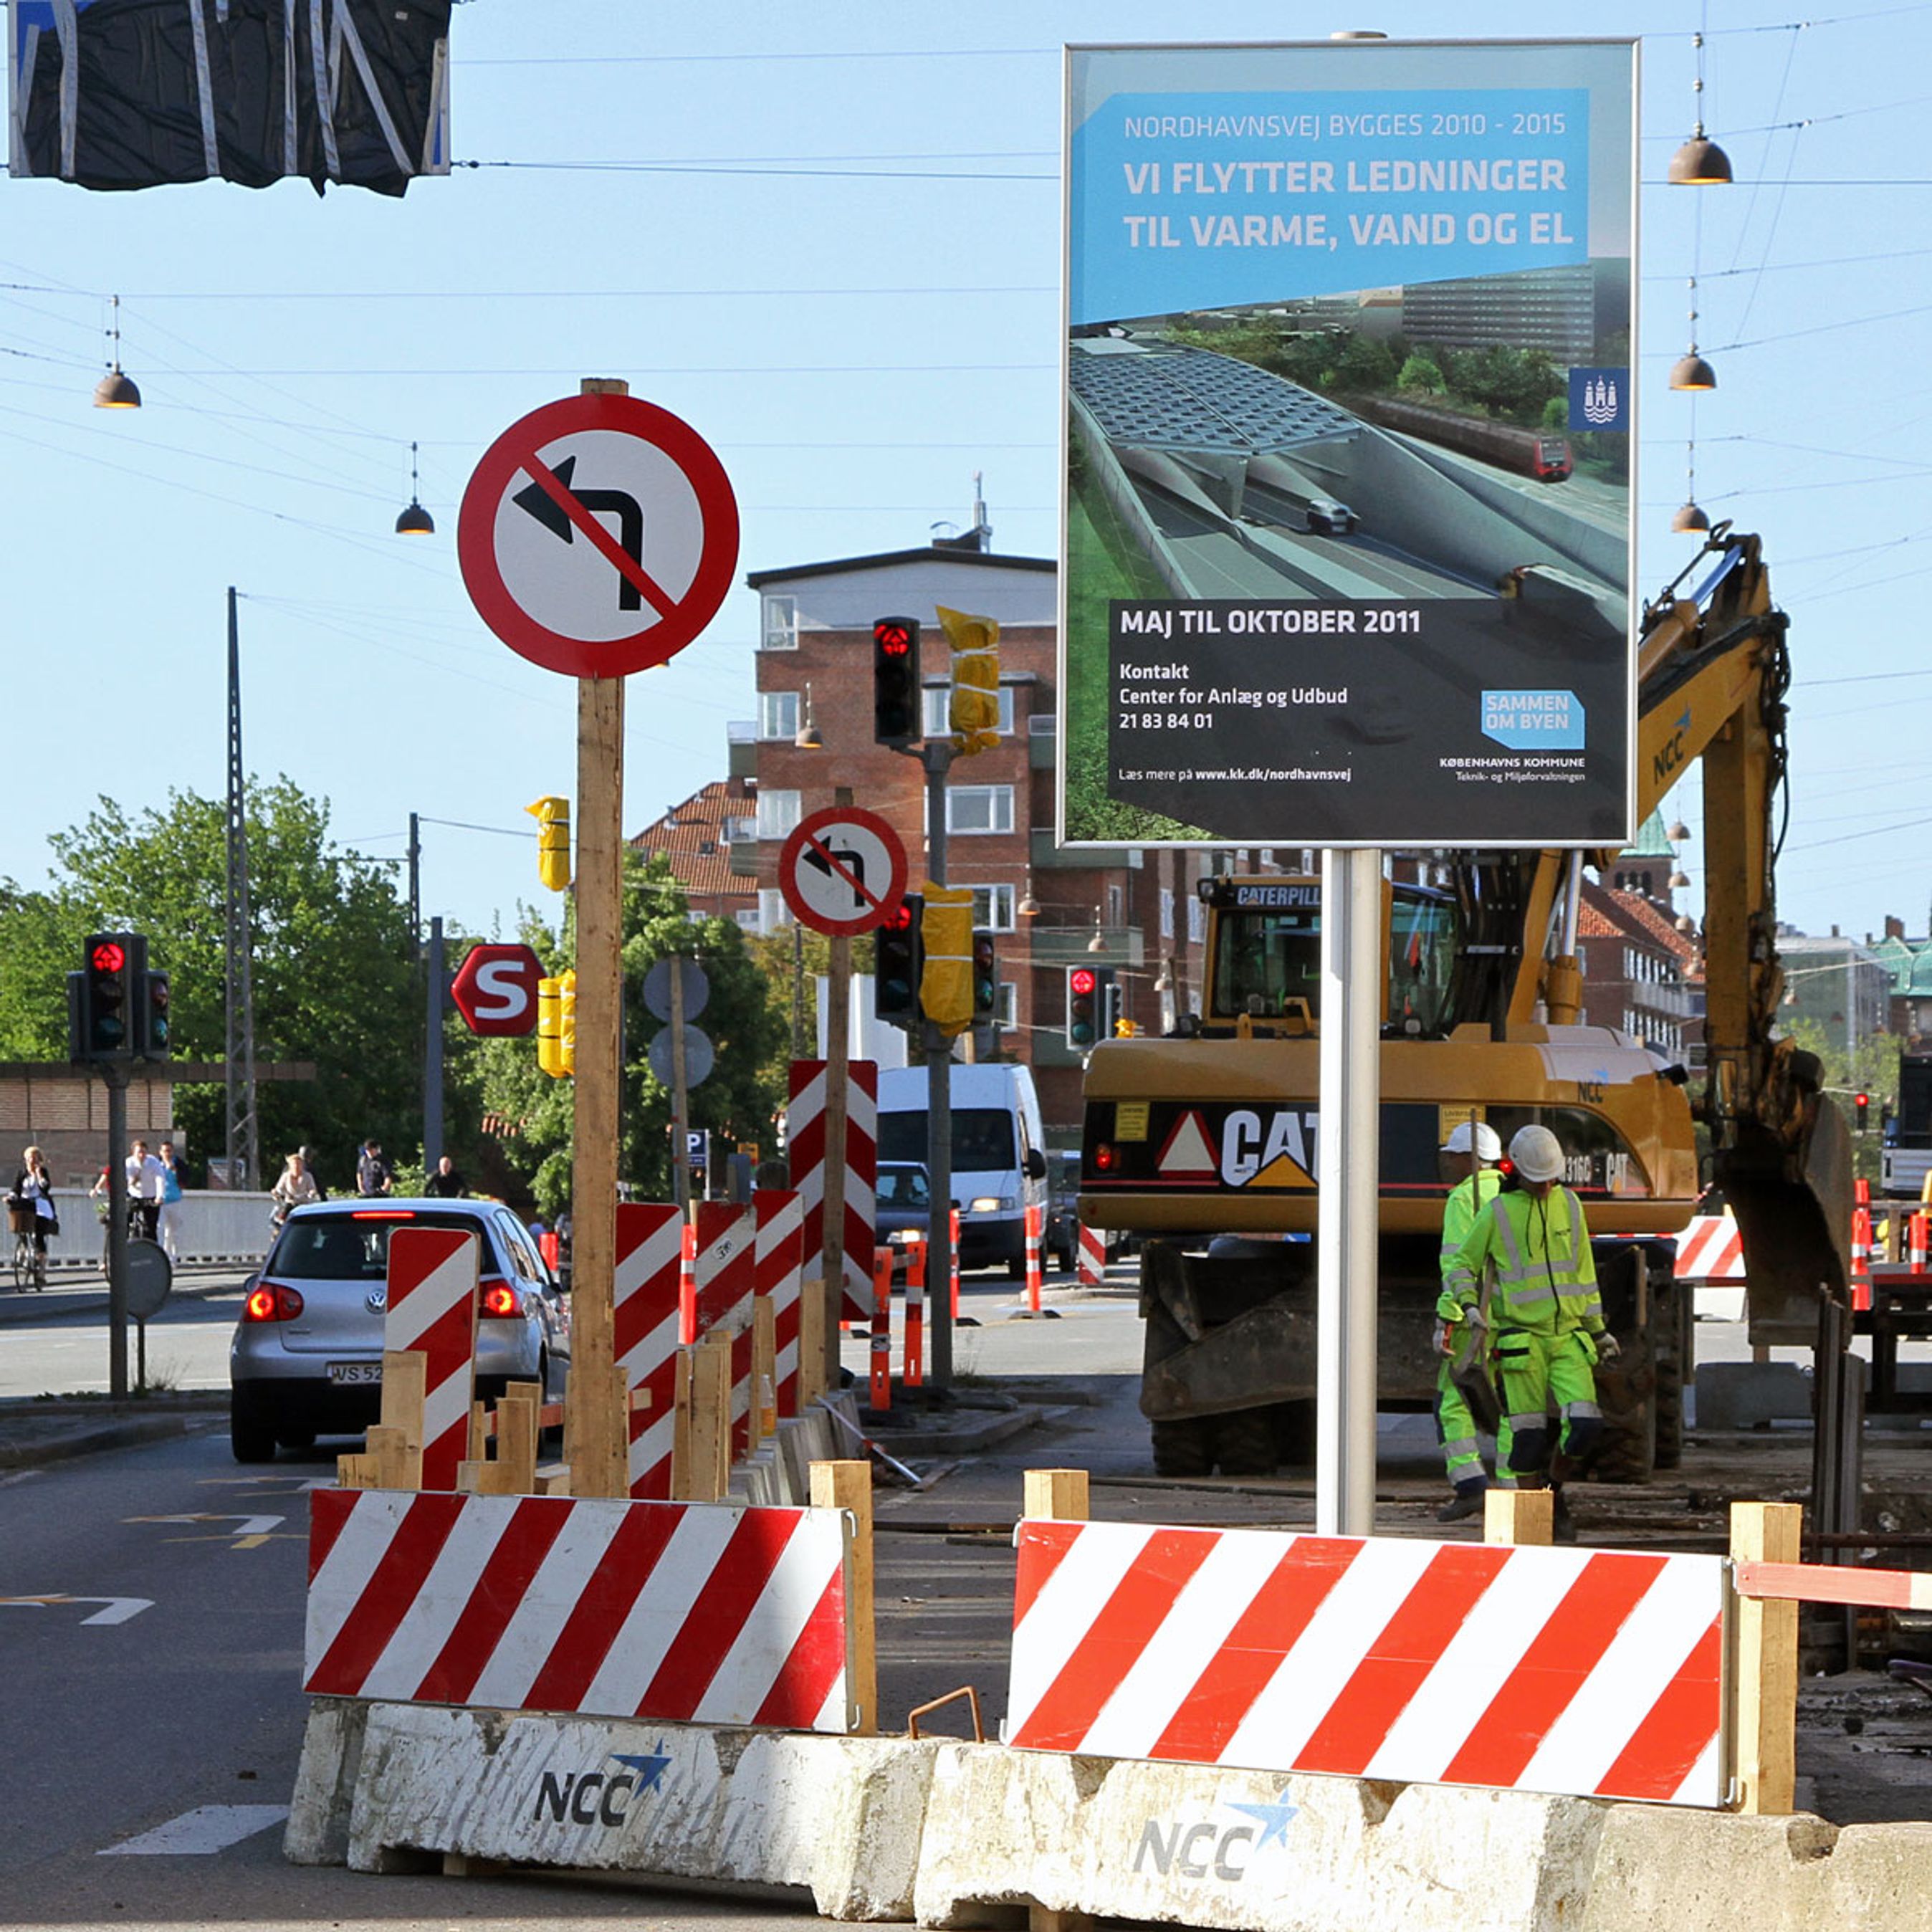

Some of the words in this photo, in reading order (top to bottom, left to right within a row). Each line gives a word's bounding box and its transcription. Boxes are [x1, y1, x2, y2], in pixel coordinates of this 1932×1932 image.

[1125, 115, 1320, 141] NORDHAVNSVEJ
[1329, 113, 1422, 137] BYGGES
[1431, 114, 1486, 135] 2010
[1512, 113, 1566, 135] 2015
[1123, 163, 1160, 194] VI
[1173, 161, 1335, 194] FLYTTER
[1347, 159, 1567, 192] LEDNINGER
[1123, 216, 1181, 247] TIL
[1190, 214, 1337, 252] VARME,
[1348, 213, 1456, 246] VAND
[1467, 212, 1517, 245] OG
[1530, 212, 1574, 244] EL
[1121, 611, 1172, 639] MAJ
[1179, 610, 1221, 633] TIL
[1228, 610, 1357, 633] OKTOBER
[1364, 610, 1420, 633] 2011
[1120, 663, 1190, 679] Kontakt
[1120, 688, 1175, 704] Center
[1178, 687, 1204, 704] for
[1208, 687, 1263, 708] Anlæg
[1266, 692, 1287, 708] og
[1291, 687, 1347, 704] Udbud
[1486, 695, 1569, 712] SAMMEN
[1119, 713, 1137, 729] 21
[1142, 713, 1162, 729] 83
[1167, 713, 1190, 729] 84
[1194, 713, 1212, 729] 01
[1486, 713, 1515, 730] OM
[1520, 713, 1569, 730] BYEN
[1440, 757, 1521, 767] KØBENHAVNS
[1524, 757, 1585, 767] KOMMUNE
[1653, 730, 1684, 785] NCC
[1119, 768, 1143, 780] Læs
[1146, 770, 1176, 780] mere
[1178, 768, 1193, 783] på
[1195, 767, 1352, 783] www.kk.dk/nordhavnsvej
[1455, 771, 1489, 781] Teknik-
[1491, 774, 1503, 783] og
[1504, 771, 1586, 783] Miljøforvaltningen
[1238, 887, 1321, 905] CATERPILL
[475, 960, 527, 1020] S
[1578, 1080, 1603, 1103] NCC
[687, 1134, 701, 1152] P
[533, 1771, 633, 1827] NCC
[1133, 1820, 1254, 1881] NCC
